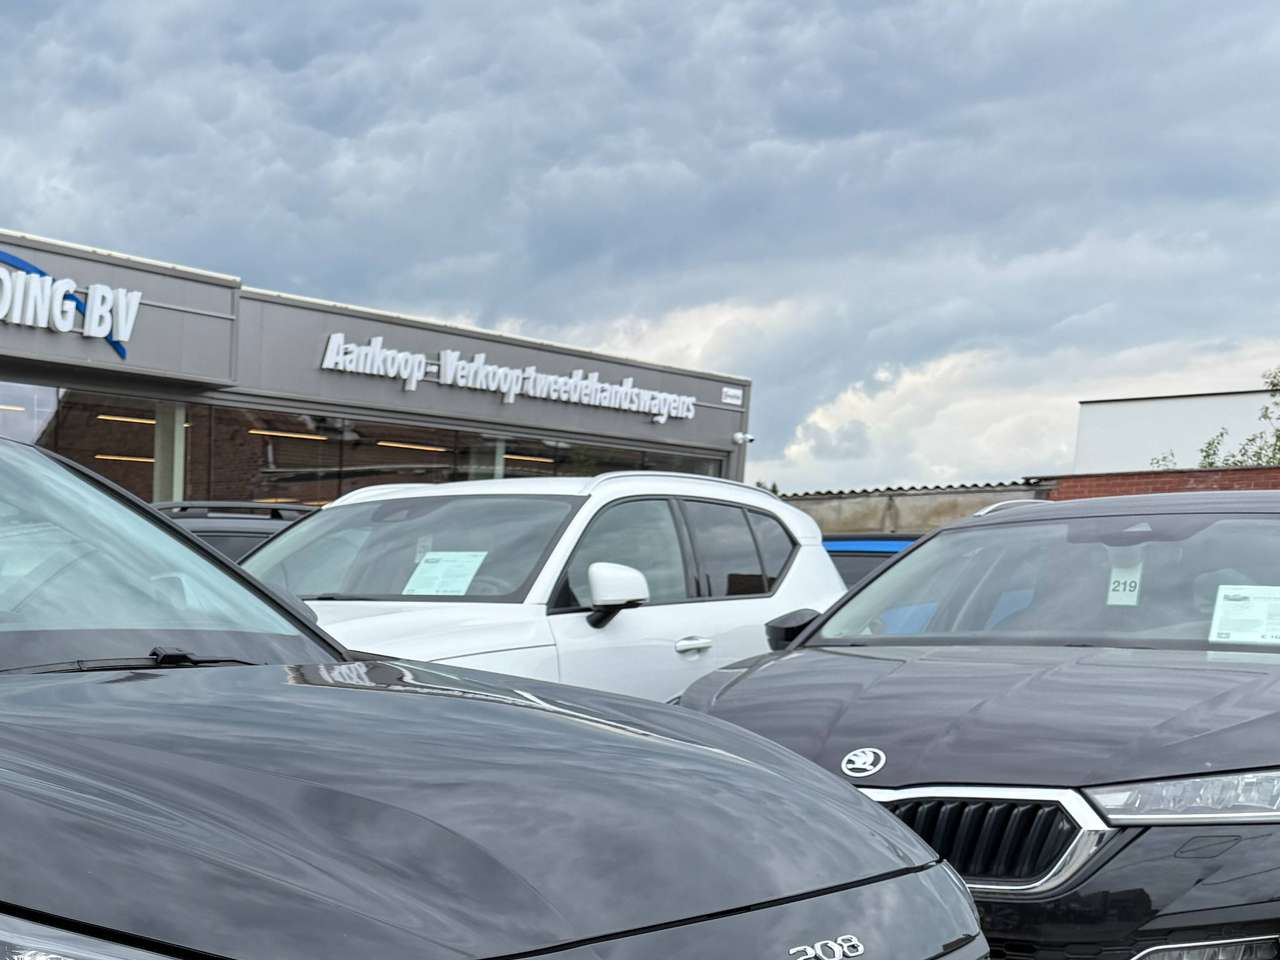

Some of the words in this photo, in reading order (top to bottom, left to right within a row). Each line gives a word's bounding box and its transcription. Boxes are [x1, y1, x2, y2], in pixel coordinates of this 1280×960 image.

[83, 283, 142, 342] BV
[321, 333, 426, 391] Aankoop
[439, 349, 522, 404] Verkoop
[523, 366, 696, 424] tweedehandswagens
[1111, 579, 1138, 593] 219
